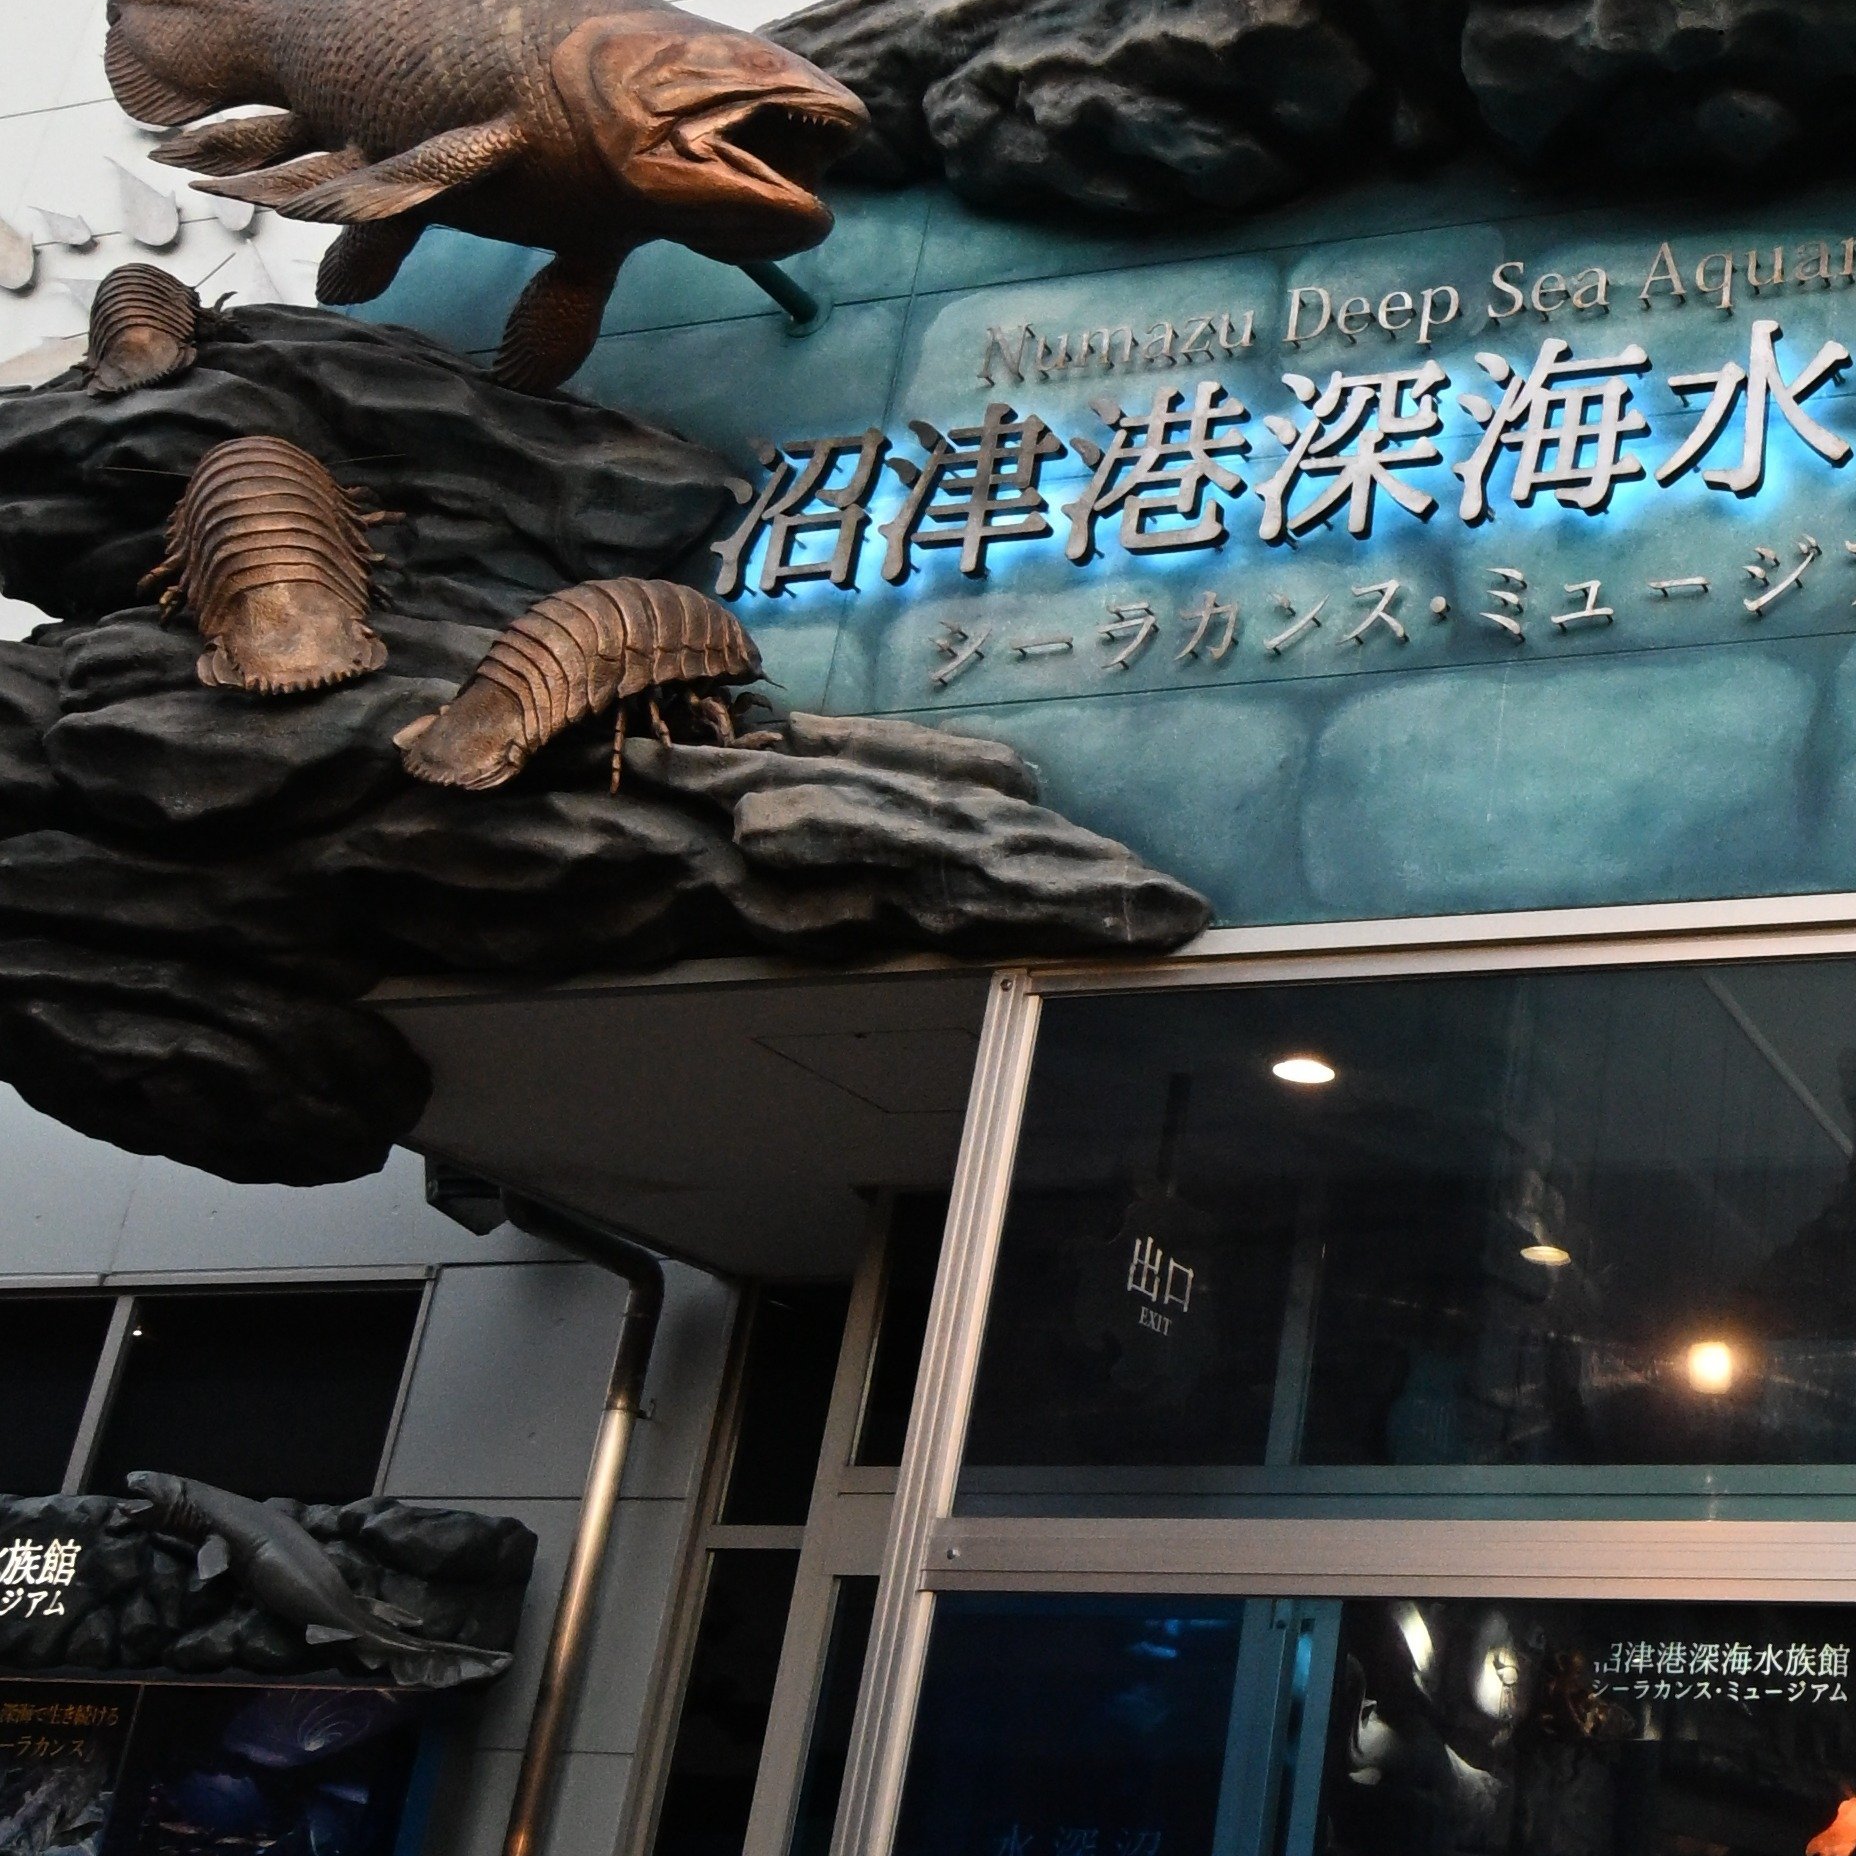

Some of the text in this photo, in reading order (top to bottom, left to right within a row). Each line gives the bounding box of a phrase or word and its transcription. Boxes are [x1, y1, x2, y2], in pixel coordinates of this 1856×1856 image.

[977, 307, 1257, 382] Numazu
[1283, 282, 1460, 346] Deep
[1486, 261, 1609, 320] Sea
[1126, 1236, 1195, 1313] 出口
[1138, 1305, 1172, 1336] EXIT
[0, 1538, 83, 1586] 族館
[1592, 1640, 1851, 1678] 沼津港深海水族館
[1591, 1679, 1849, 1703] シーラカンス・ミュージアム
